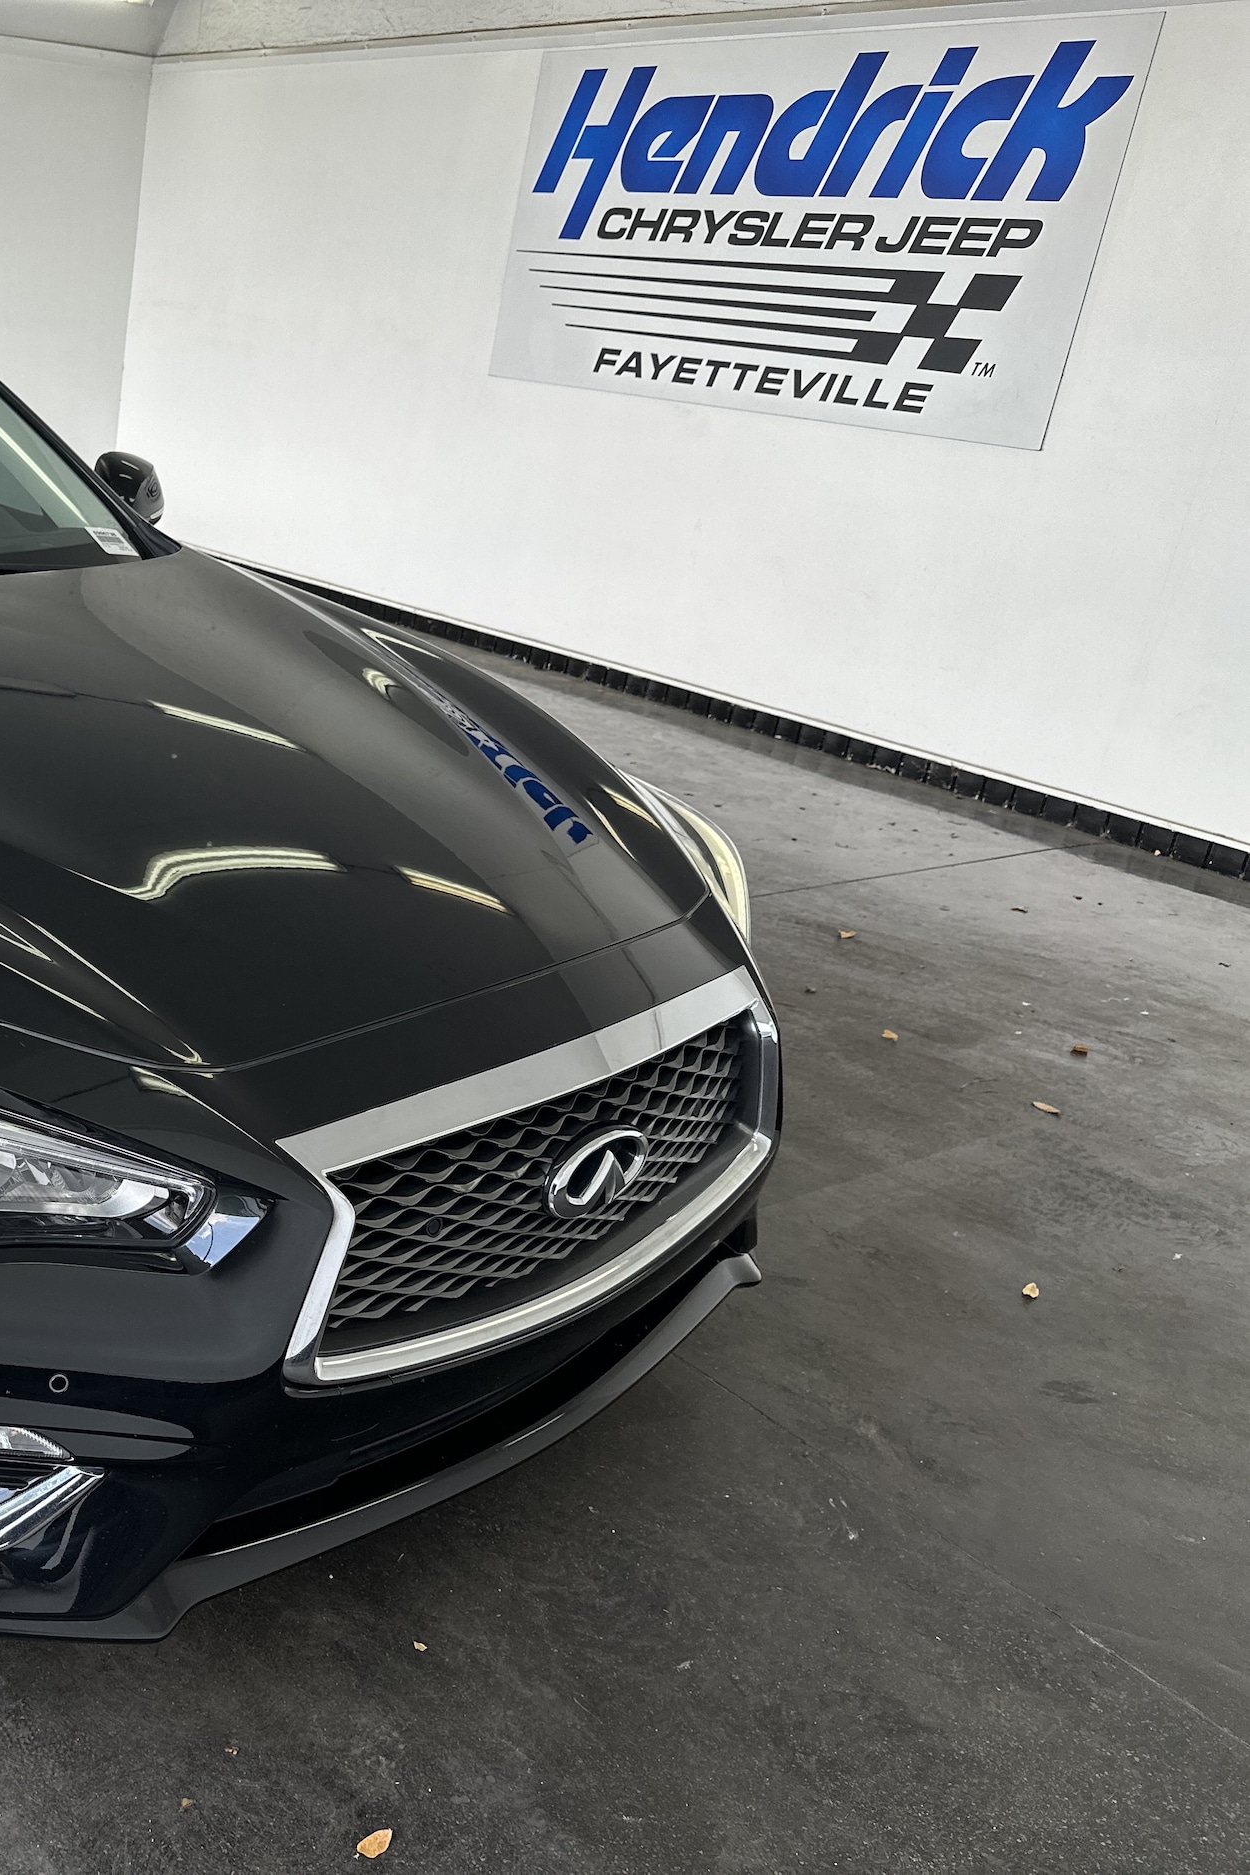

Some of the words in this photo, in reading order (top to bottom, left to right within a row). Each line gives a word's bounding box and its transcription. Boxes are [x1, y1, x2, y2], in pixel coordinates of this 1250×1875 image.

[532, 39, 1134, 239] Hendrick
[597, 207, 875, 252] CHRYSLER
[874, 216, 1043, 258] JEEP
[592, 348, 935, 415] FAYETTEVILLE
[970, 362, 996, 378] TM
